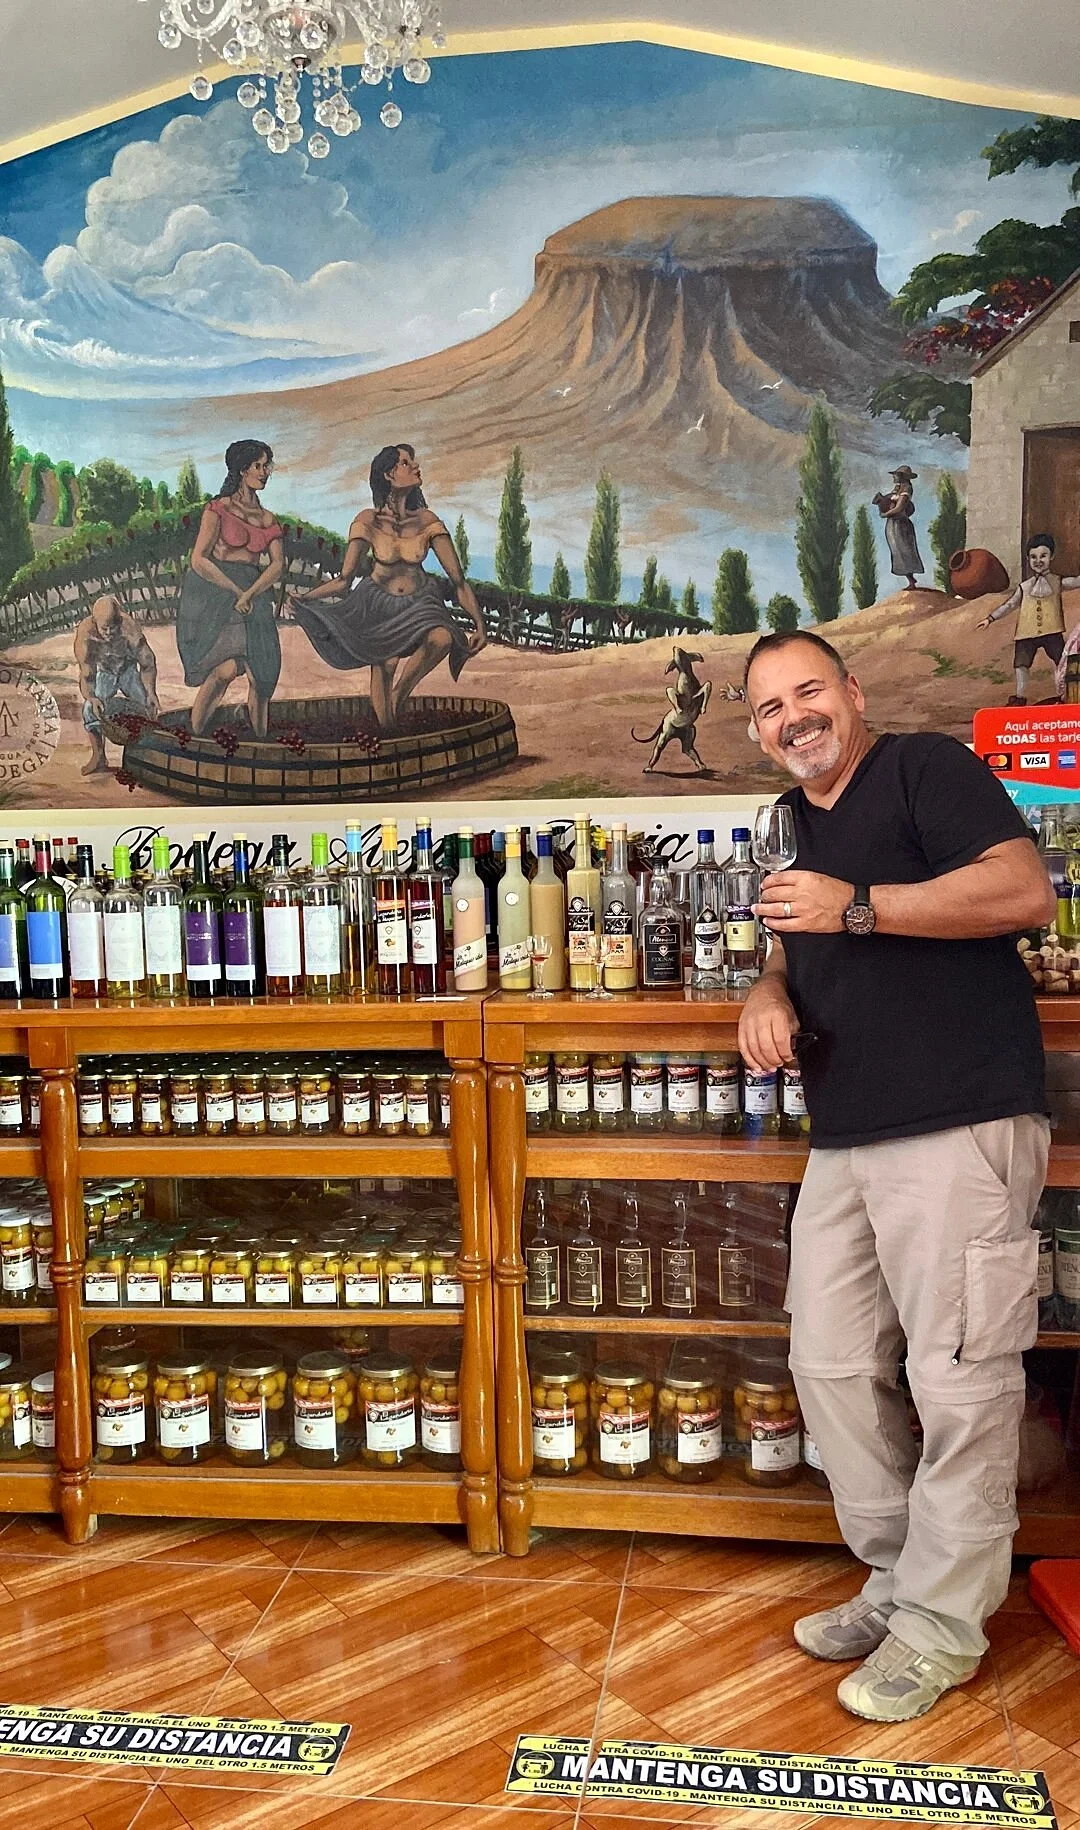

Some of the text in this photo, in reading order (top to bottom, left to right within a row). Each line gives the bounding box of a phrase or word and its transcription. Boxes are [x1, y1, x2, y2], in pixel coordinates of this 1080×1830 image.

[996, 733, 1036, 745] TODAS
[1039, 734, 1056, 743] las
[1004, 721, 1029, 732] Aquí
[1024, 756, 1047, 766] VISA
[37, 1711, 94, 1721] MANTENGA
[115, 1716, 169, 1726] DISTANCIA
[239, 1723, 267, 1731] OTRO
[288, 1726, 332, 1734] METROS
[0, 1718, 292, 1758] ENGA SU DISTANCIA
[9, 1746, 69, 1756] MANTENGA
[89, 1751, 146, 1762] DISTANCIA
[149, 1756, 163, 1764] EL
[165, 1757, 189, 1765] UNO
[195, 1758, 215, 1766] DEL
[218, 1759, 248, 1768] OTRO
[251, 1761, 267, 1769] 1.5
[269, 1763, 315, 1771] METROS
[543, 1743, 580, 1752] LUCHA
[632, 1748, 683, 1759] COVID-19
[692, 1753, 757, 1764] MANTENGA
[760, 1758, 776, 1766] SU
[779, 1760, 841, 1771] DISTANCIA
[845, 1764, 859, 1772] EL
[862, 1766, 888, 1774] UNO
[895, 1768, 917, 1776] DEL
[921, 1770, 953, 1778] OTRO
[956, 1772, 974, 1780] 1.5
[976, 1773, 1027, 1784] METROS
[561, 1755, 999, 1808] MANTENGA SU DISTANCIA
[533, 1781, 572, 1791] LUCHA
[626, 1786, 680, 1798] COVID-19
[689, 1792, 757, 1805] MANTENGA
[760, 1797, 776, 1805] SU
[779, 1799, 844, 1811] DISTANCIA
[848, 1804, 863, 1812] EL
[866, 1806, 893, 1814] UNO
[900, 1808, 922, 1817] DEL
[927, 1810, 960, 1819] OTRO
[964, 1812, 982, 1821] 1.5
[985, 1814, 1037, 1825] METROS
